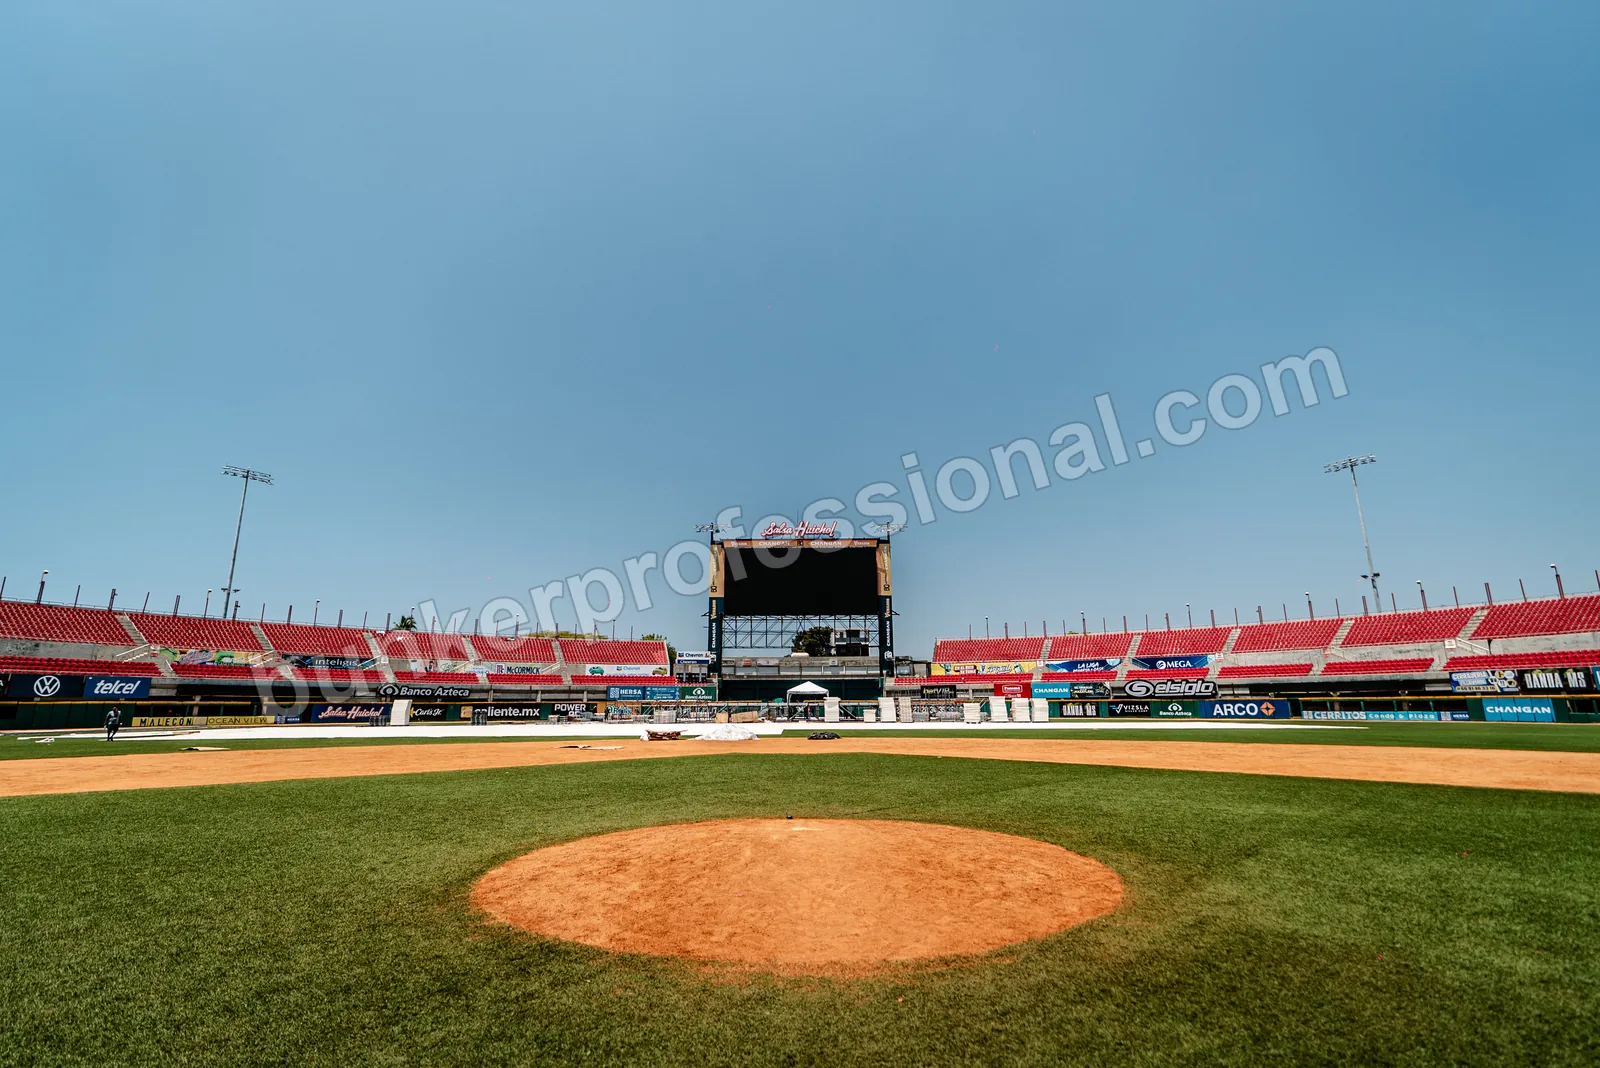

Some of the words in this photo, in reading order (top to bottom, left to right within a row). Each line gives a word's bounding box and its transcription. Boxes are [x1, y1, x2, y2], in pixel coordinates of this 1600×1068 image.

[761, 521, 793, 537] Salsa
[795, 521, 837, 538] Huichol
[1524, 673, 1564, 688] BANDA
[1567, 672, 1587, 688] MS
[94, 680, 141, 694] telcel
[400, 687, 432, 696] Banco
[434, 687, 470, 697] Azteca
[1155, 681, 1214, 695] elsiglo
[318, 706, 346, 718] Salsa
[346, 706, 384, 719] Huichol
[1213, 703, 1258, 716] ARCO
[1313, 711, 1366, 720] CERRITOS
[1486, 706, 1551, 714] CHANGAN
[140, 717, 192, 726] MALECON
